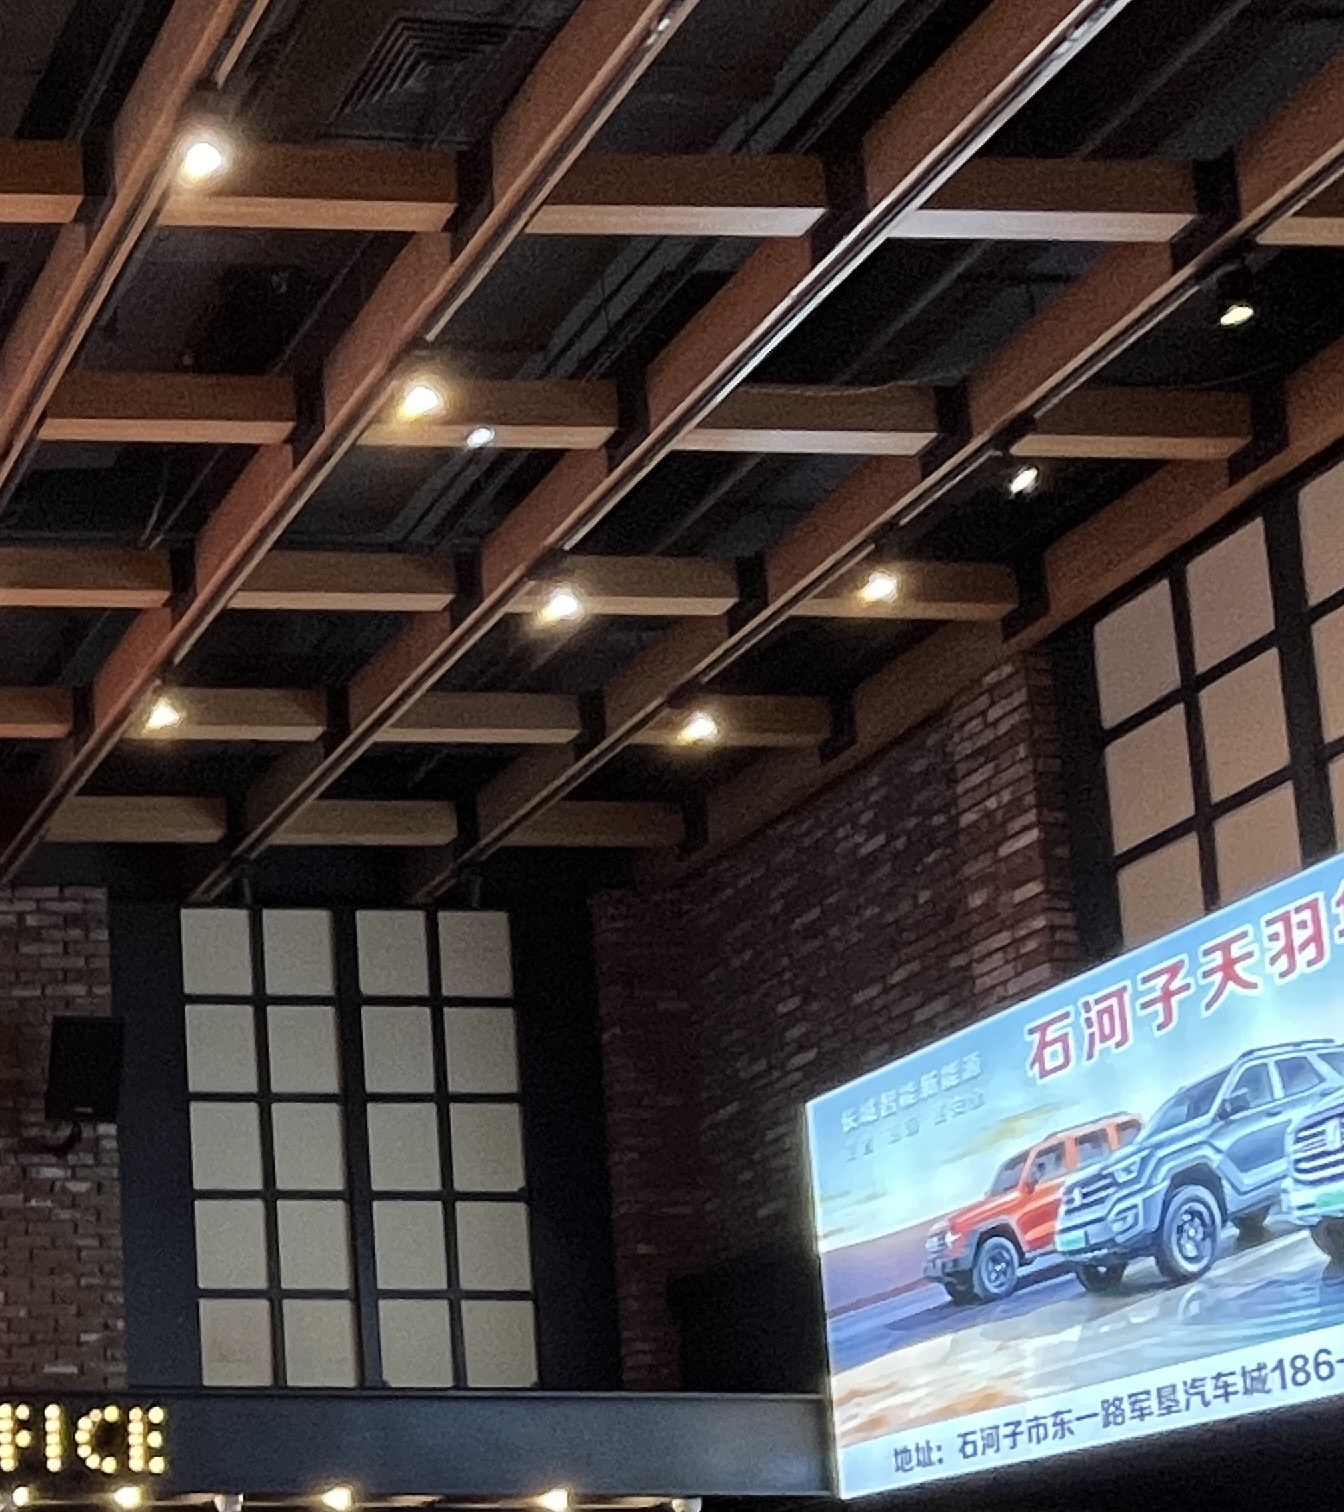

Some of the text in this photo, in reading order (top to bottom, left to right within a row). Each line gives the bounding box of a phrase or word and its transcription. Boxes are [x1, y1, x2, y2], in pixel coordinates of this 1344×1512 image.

[1027, 888, 1344, 1081] 石河子天羽
